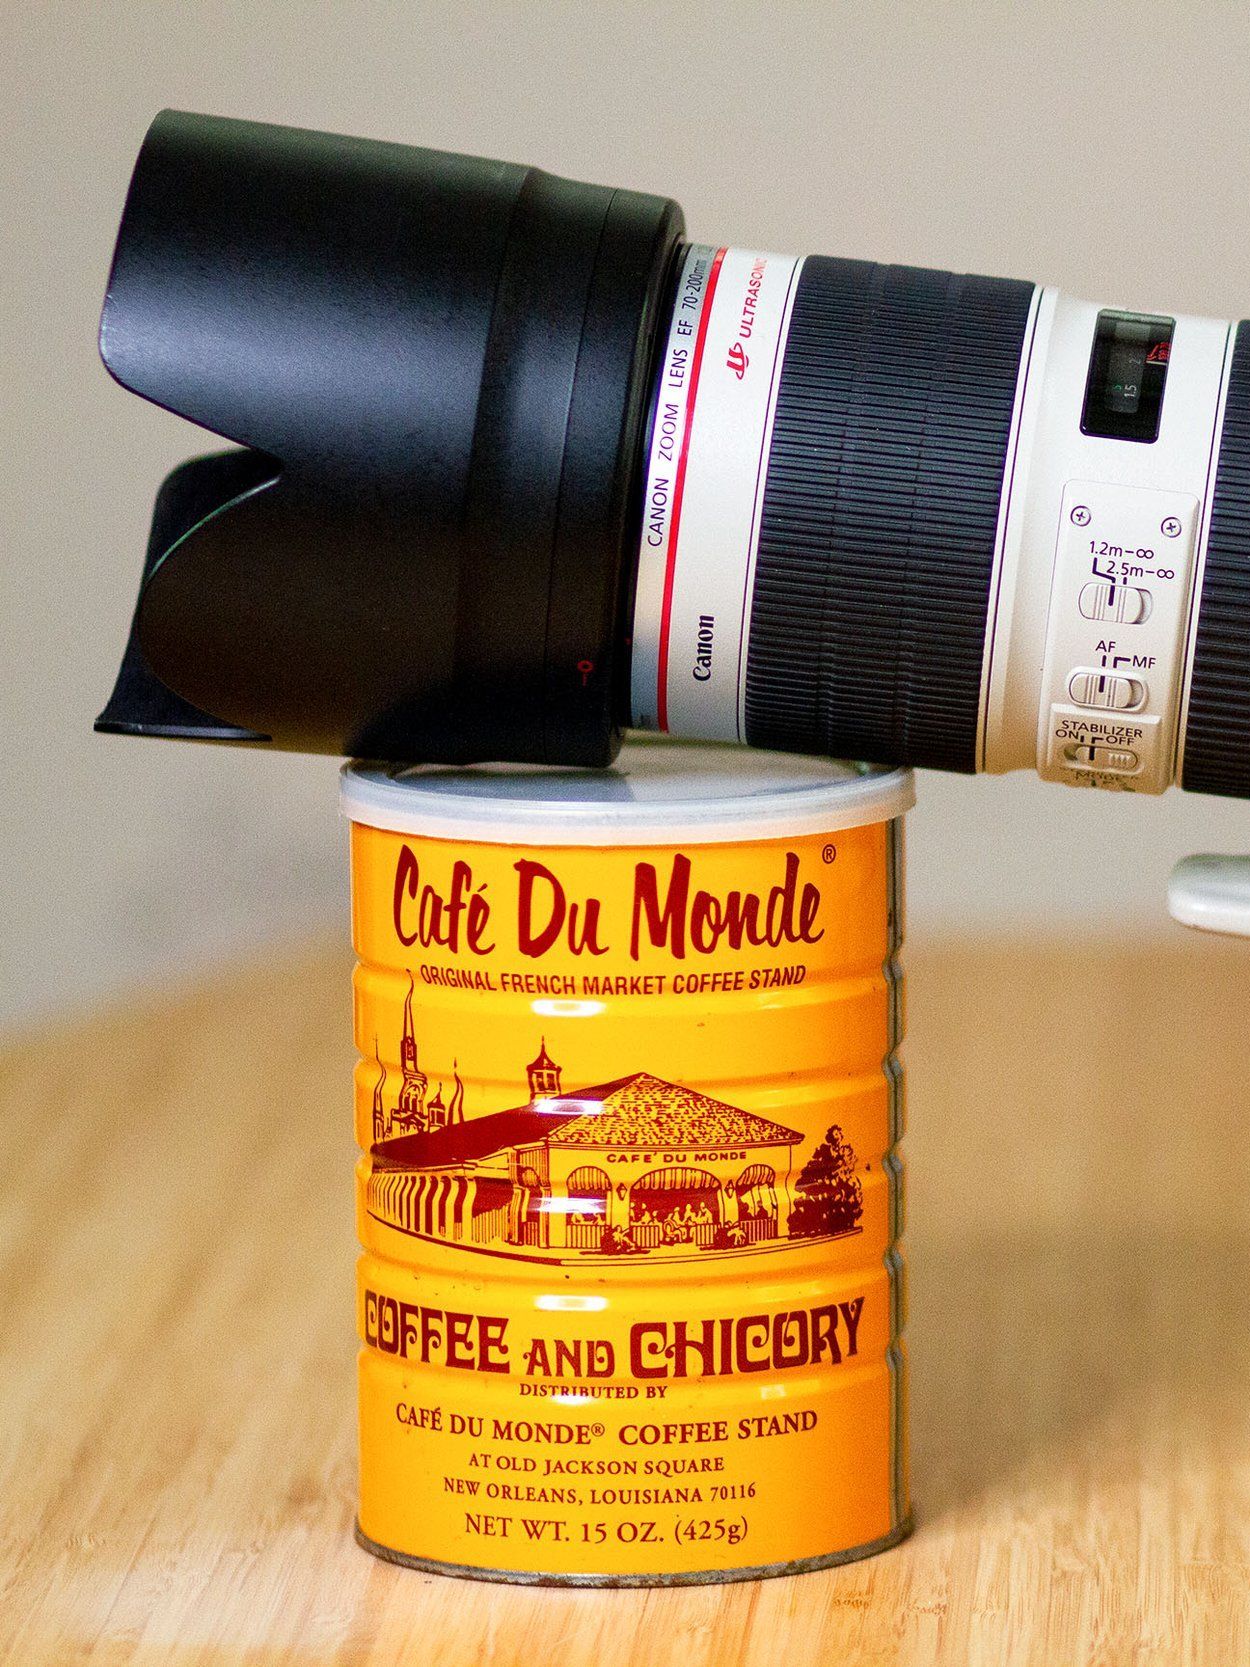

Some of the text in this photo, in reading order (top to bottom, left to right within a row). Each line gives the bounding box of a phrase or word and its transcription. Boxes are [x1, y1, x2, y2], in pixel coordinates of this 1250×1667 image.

[677, 320, 693, 336] EF
[669, 348, 688, 388] LENS
[658, 404, 680, 460] ZOOM
[648, 478, 669, 547] CANON
[692, 614, 715, 682] Canon
[1096, 640, 1116, 653] AF
[1133, 655, 1156, 669] MF
[1055, 729, 1079, 740] ON
[1061, 720, 1143, 738] STABILIZER
[1106, 735, 1134, 746] OFF
[394, 845, 495, 955] Café
[514, 859, 609, 958] Du
[630, 852, 825, 961] Monde
[420, 965, 806, 995] ORIGINAL FRENCH MARKET COFFEE STAND
[664, 1154, 686, 1162] DU
[694, 1151, 746, 1162] MONDE
[365, 1290, 865, 1378] COFFEE AND CHICORY
[519, 1383, 667, 1399] DISTRIBUTED BY
[397, 1403, 442, 1431] CAFÉ
[450, 1414, 483, 1437] DU
[619, 1421, 728, 1445] COFFEE
[738, 1411, 817, 1439] STAND
[469, 1454, 724, 1477] AT OLD JACKSON SQUARE
[445, 1477, 755, 1505] NEW ORLEANS, LOUISIANA 70116
[466, 1513, 747, 1545] NET WT. 15 OZ. (425g)
